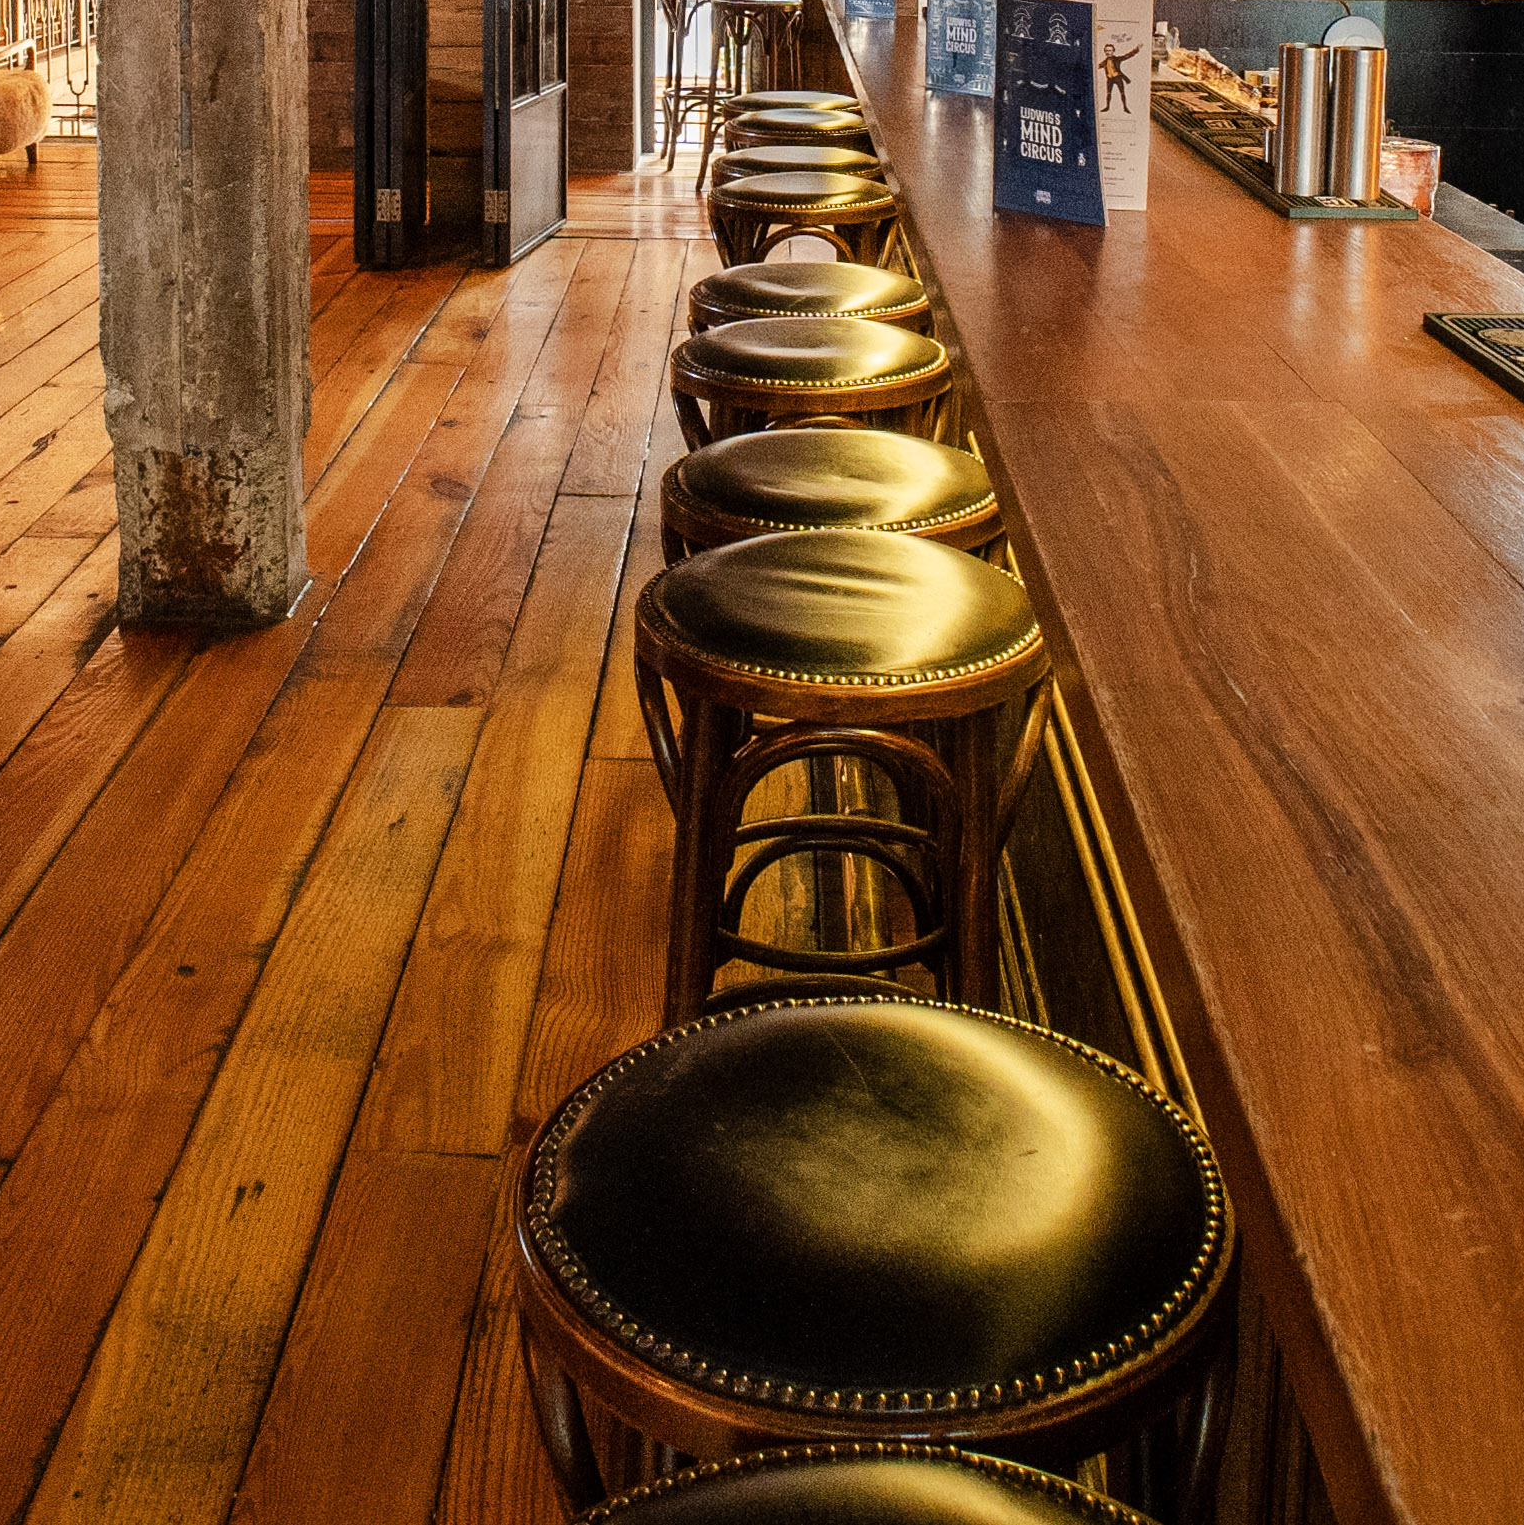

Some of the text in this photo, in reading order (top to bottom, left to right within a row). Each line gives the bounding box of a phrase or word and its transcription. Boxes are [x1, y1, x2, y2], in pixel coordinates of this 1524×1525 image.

[946, 26, 977, 43] MIND
[946, 40, 976, 55] CIRCUS
[1020, 106, 1061, 125] LUDWIG'S
[1020, 120, 1063, 146] MIND
[1020, 142, 1063, 164] CIRCUS
